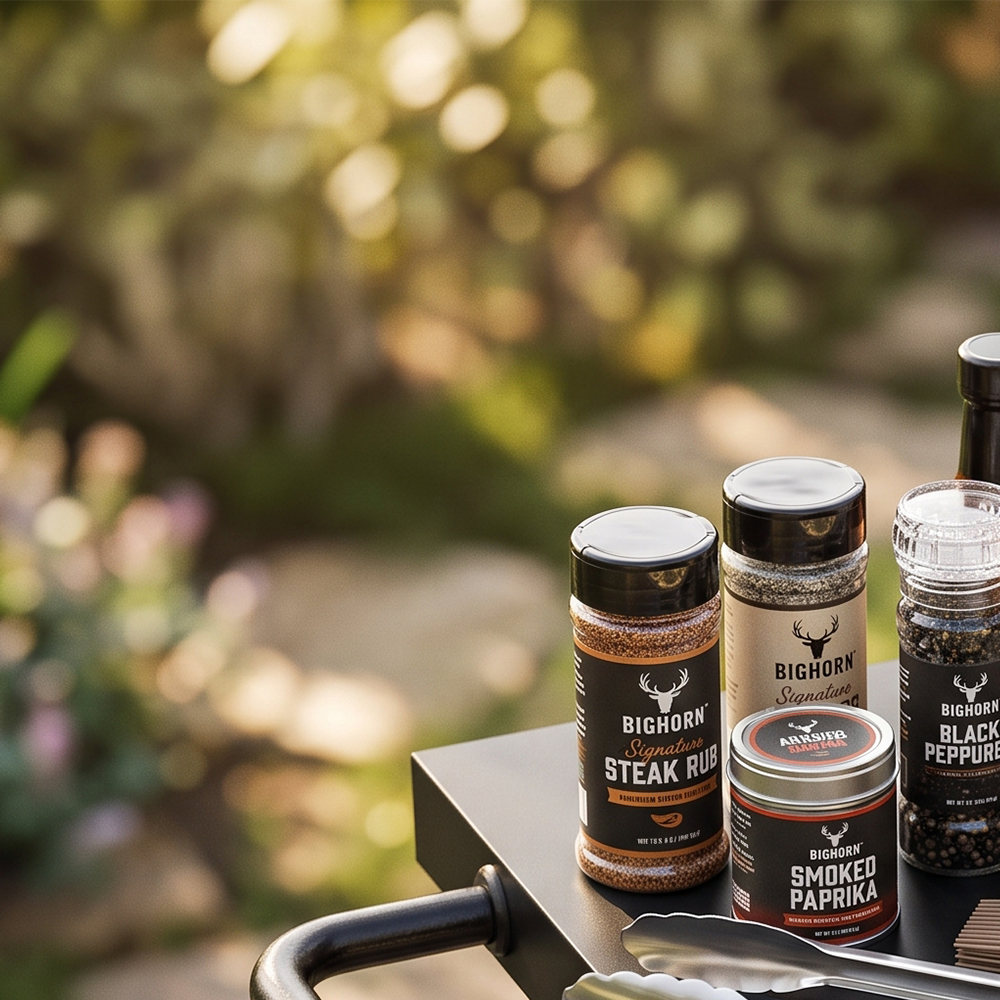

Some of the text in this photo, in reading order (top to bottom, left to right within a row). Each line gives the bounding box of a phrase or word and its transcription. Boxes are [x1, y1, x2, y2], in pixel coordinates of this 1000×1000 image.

[775, 652, 853, 680] BIGHORN
[776, 683, 851, 705] Signature
[941, 699, 999, 717] BIGHORN
[622, 706, 704, 735] BIGHORN
[940, 719, 1000, 744] BLACK
[605, 743, 718, 785] STEAK RUB
[625, 737, 704, 766] Signature
[809, 843, 860, 861] BIGHORN
[791, 855, 876, 888] SMOKED
[790, 879, 878, 911] PAPRIKA
